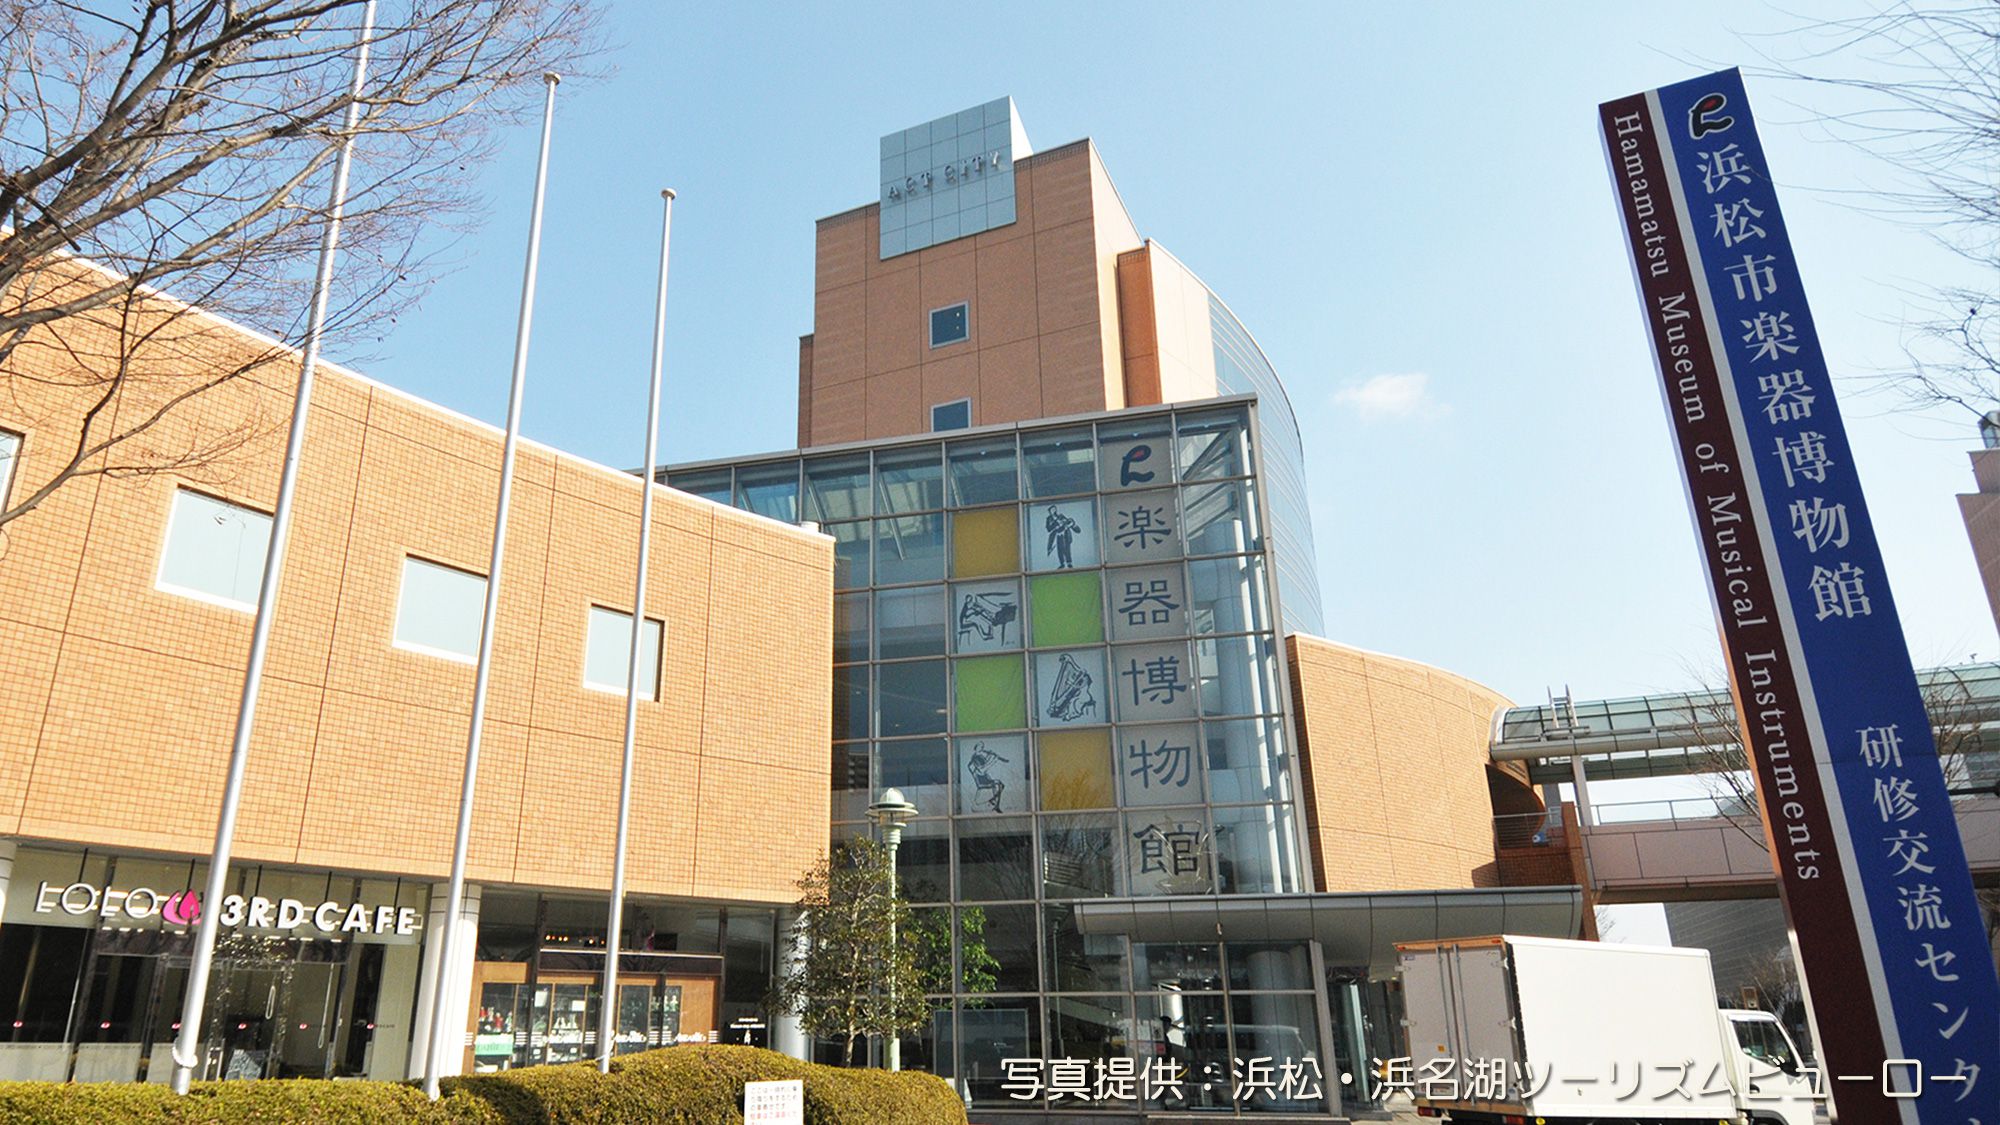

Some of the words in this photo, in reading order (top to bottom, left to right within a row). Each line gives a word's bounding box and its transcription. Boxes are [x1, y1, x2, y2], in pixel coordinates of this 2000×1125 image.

[888, 172, 930, 199] ACT
[944, 151, 999, 182] CITY
[1614, 111, 1668, 277] Hamamatsu
[1658, 292, 1706, 424] Museum
[1694, 443, 1729, 475] of
[1706, 493, 1767, 629] Musical
[1113, 504, 1201, 877] 楽器博物館
[1695, 142, 1873, 622] 浜松市楽器博物館
[1855, 723, 1981, 1125] 研修交流センタ
[1744, 649, 1820, 881] Instruments
[219, 894, 305, 930] 3RD
[314, 900, 417, 935] CAFE
